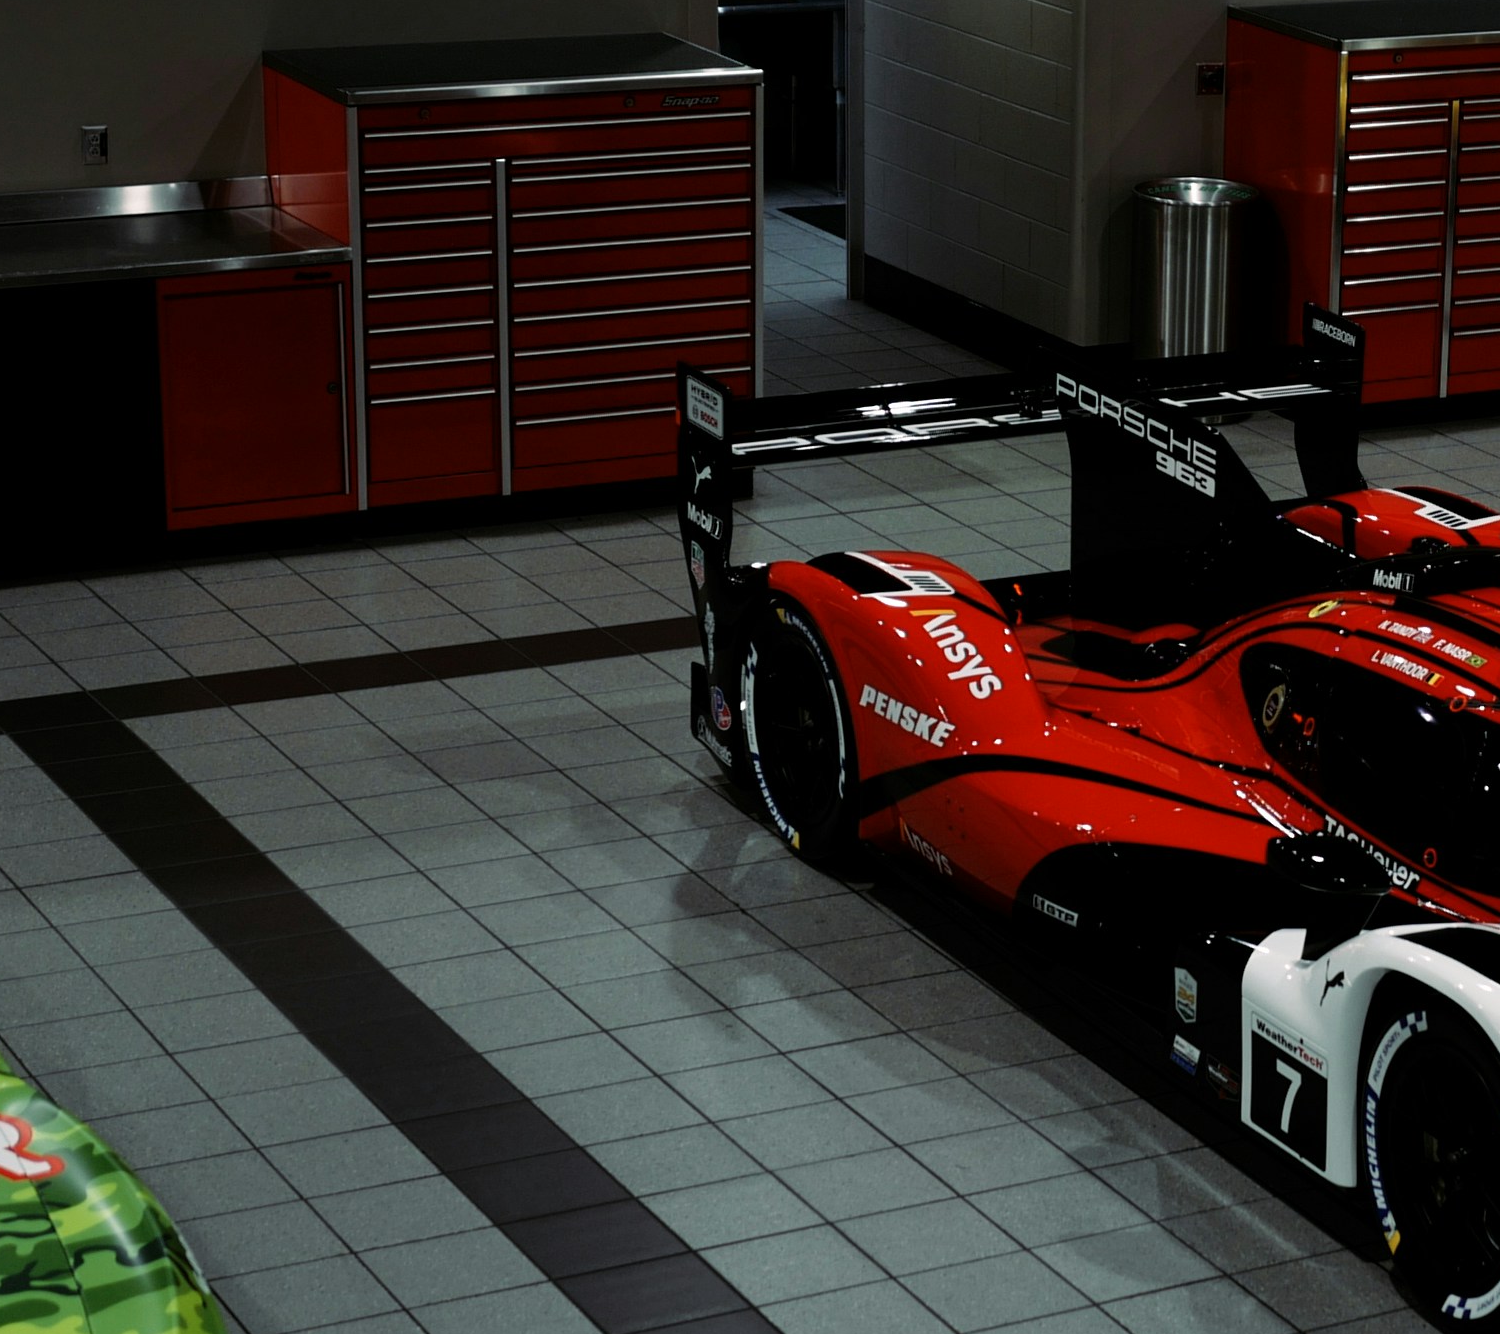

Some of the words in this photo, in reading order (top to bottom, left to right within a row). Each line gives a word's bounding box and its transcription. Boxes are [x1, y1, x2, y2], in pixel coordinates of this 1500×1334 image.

[660, 96, 720, 110] Snap-on
[1319, 320, 1357, 348] RACEBORN
[690, 383, 719, 407] HYBRID
[699, 409, 719, 428] BOSCH
[1055, 372, 1218, 475] PORSCHE
[1155, 450, 1217, 499] 963
[686, 501, 713, 530] Mobil
[1373, 568, 1402, 591] Mobil
[908, 608, 1002, 702] Ansys
[1442, 641, 1474, 662] NASR
[859, 682, 957, 749] PENSKE
[899, 817, 955, 880] Ansys
[1046, 903, 1076, 923] GTP
[1256, 1017, 1324, 1071] WeatherTech
[1372, 1058, 1388, 1085] PILOT
[1381, 1030, 1402, 1061] SPORT
[1275, 1058, 1303, 1135] 7
[1365, 1097, 1390, 1212] MICHELIN
